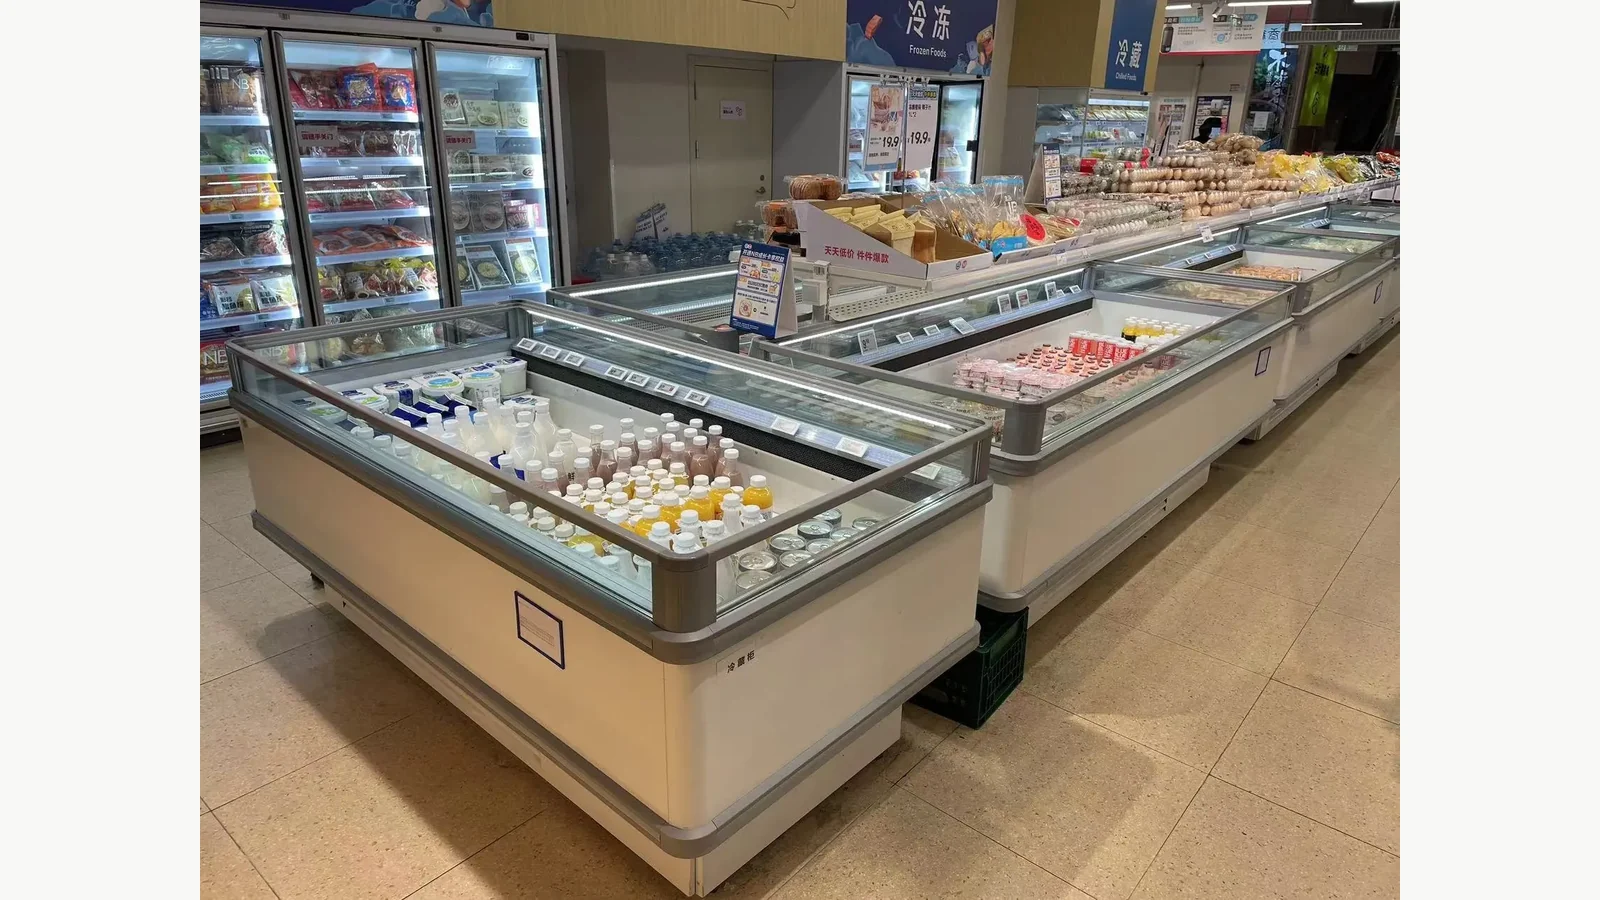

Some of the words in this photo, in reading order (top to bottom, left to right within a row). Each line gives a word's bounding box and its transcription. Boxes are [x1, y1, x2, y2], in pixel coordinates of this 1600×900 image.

[906, 0, 951, 40] 冷冻
[909, 44, 930, 56] Frozen
[930, 47, 947, 58] Foods
[1115, 39, 1142, 68] 冷藏
[883, 136, 899, 148] 19.9
[825, 245, 854, 259] 天天低价
[857, 250, 889, 264] 件件爆款
